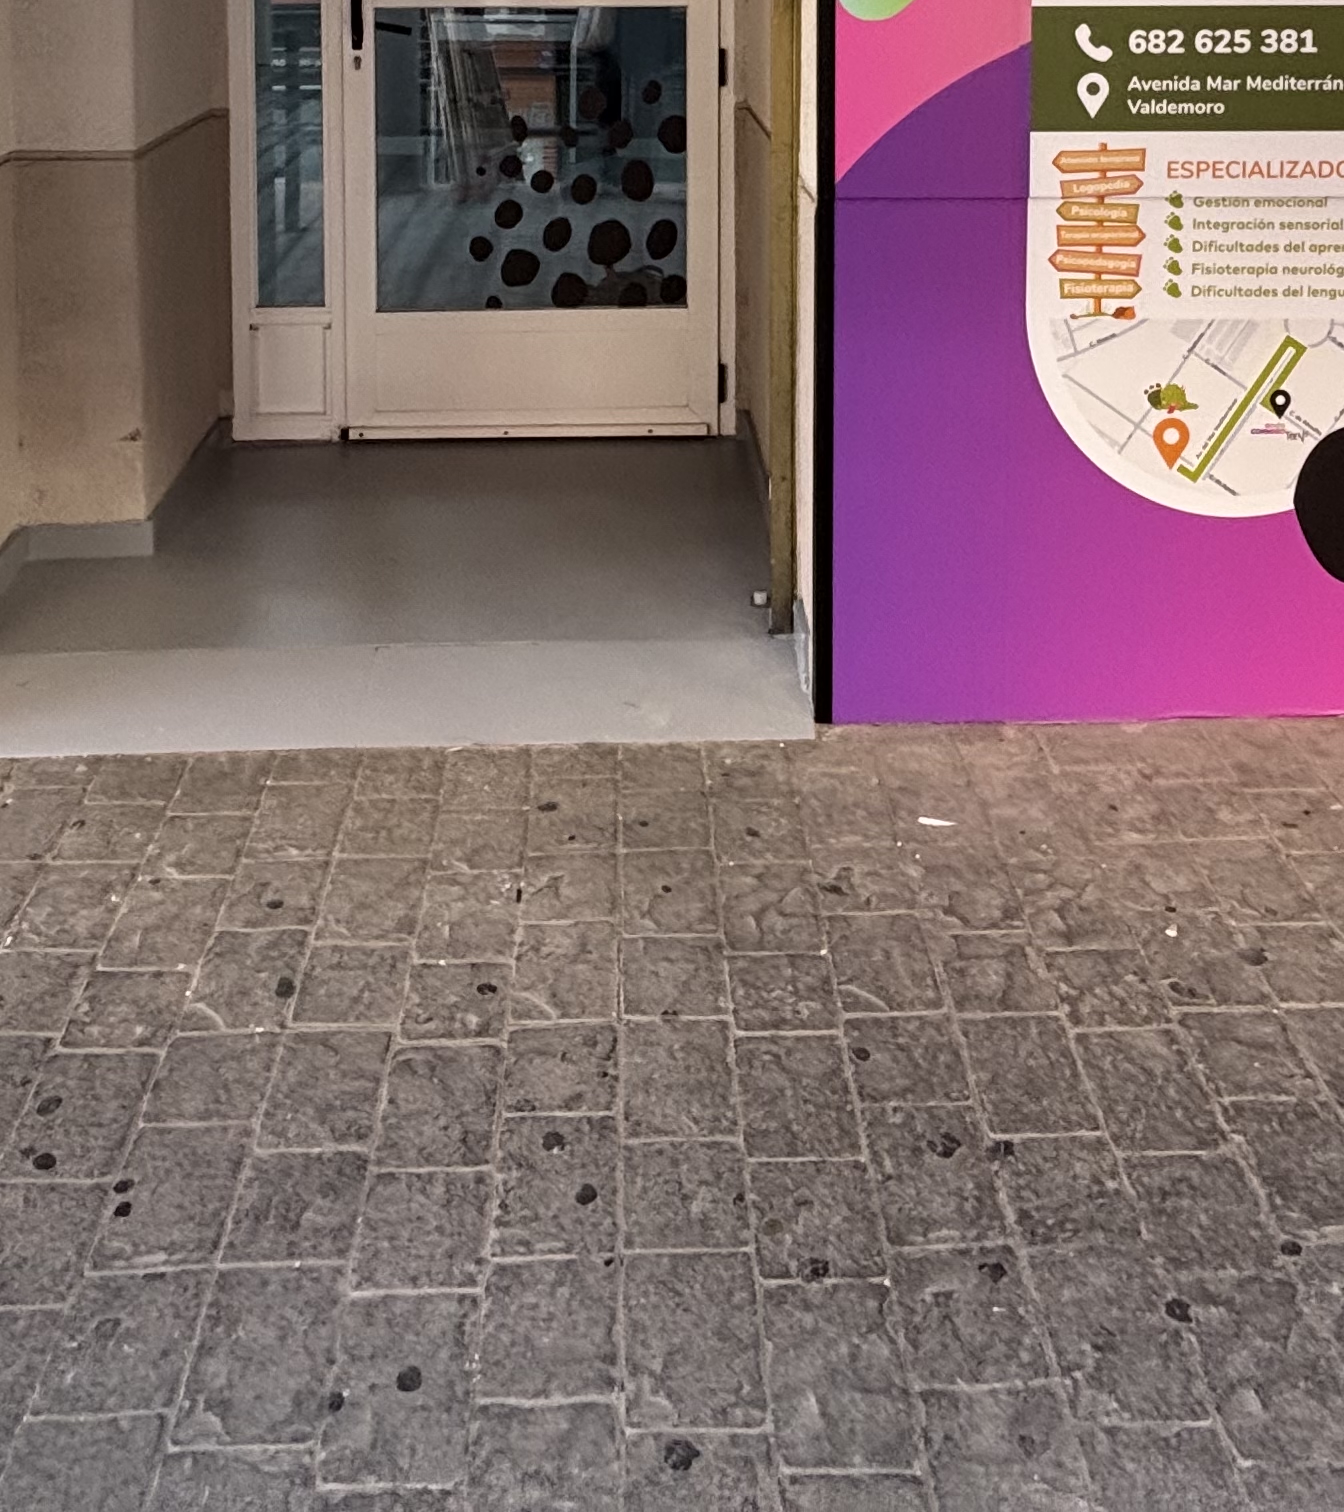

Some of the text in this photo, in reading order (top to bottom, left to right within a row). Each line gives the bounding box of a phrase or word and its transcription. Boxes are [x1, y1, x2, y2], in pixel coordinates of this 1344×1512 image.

[1128, 28, 1318, 55] 682 625 381
[1127, 76, 1200, 92] Avenida
[1207, 76, 1239, 92] Mar
[1127, 99, 1225, 116] Valdemoro
[1073, 180, 1131, 195] Logopedia
[1193, 196, 1328, 208] Gestión emocional
[1192, 218, 1344, 232] Integración sensorial
[1192, 240, 1280, 253] Dificultades
[1284, 241, 1306, 253] del
[1191, 263, 1278, 278] Fisioterapia
[1191, 285, 1280, 298] Dificultades
[1282, 285, 1303, 298] del
